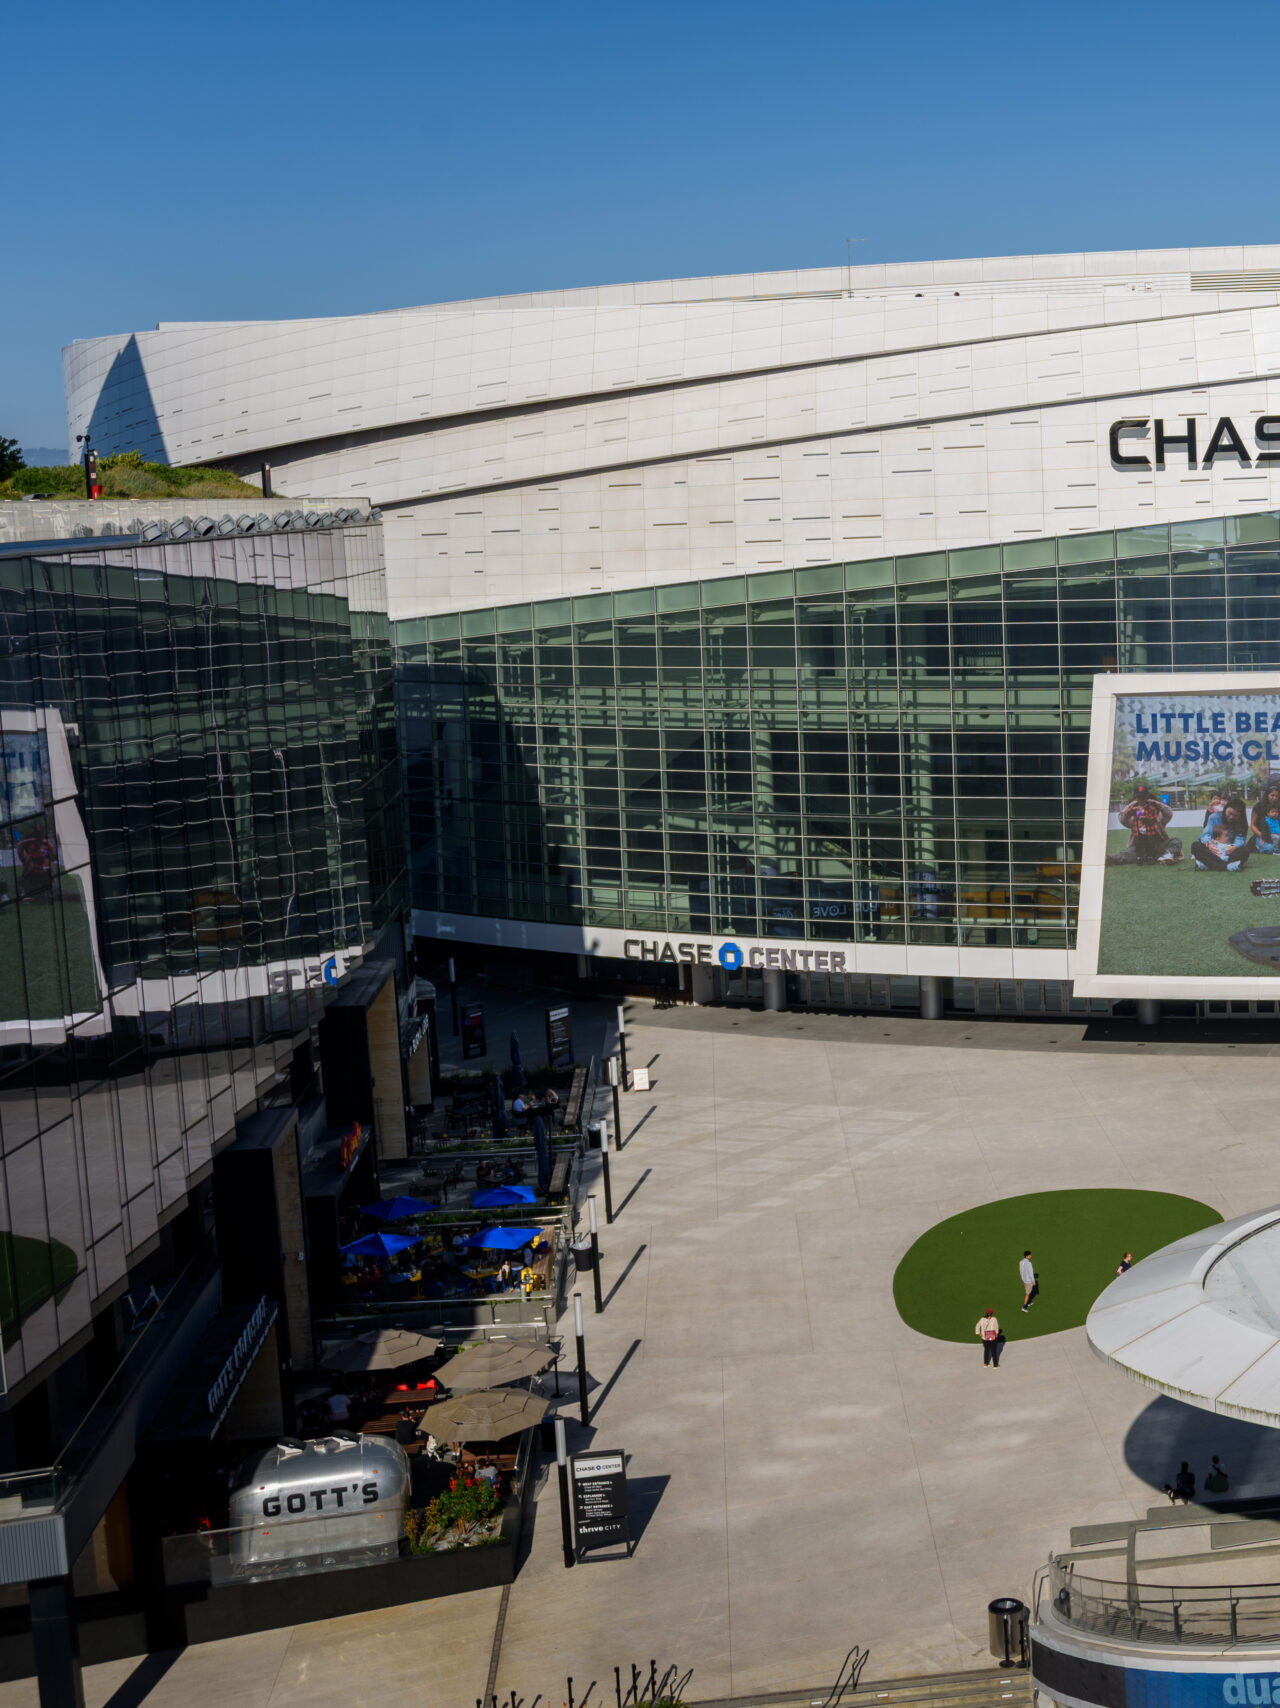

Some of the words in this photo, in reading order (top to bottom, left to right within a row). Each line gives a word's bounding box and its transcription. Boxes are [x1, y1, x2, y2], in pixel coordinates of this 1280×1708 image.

[1136, 713, 1227, 733] LITTLE
[1136, 740, 1233, 761] MUSIC
[623, 938, 713, 965] CHASE
[749, 946, 847, 973] CENTER
[262, 1482, 379, 1517] GOTT'S
[580, 1526, 603, 1534] thrive
